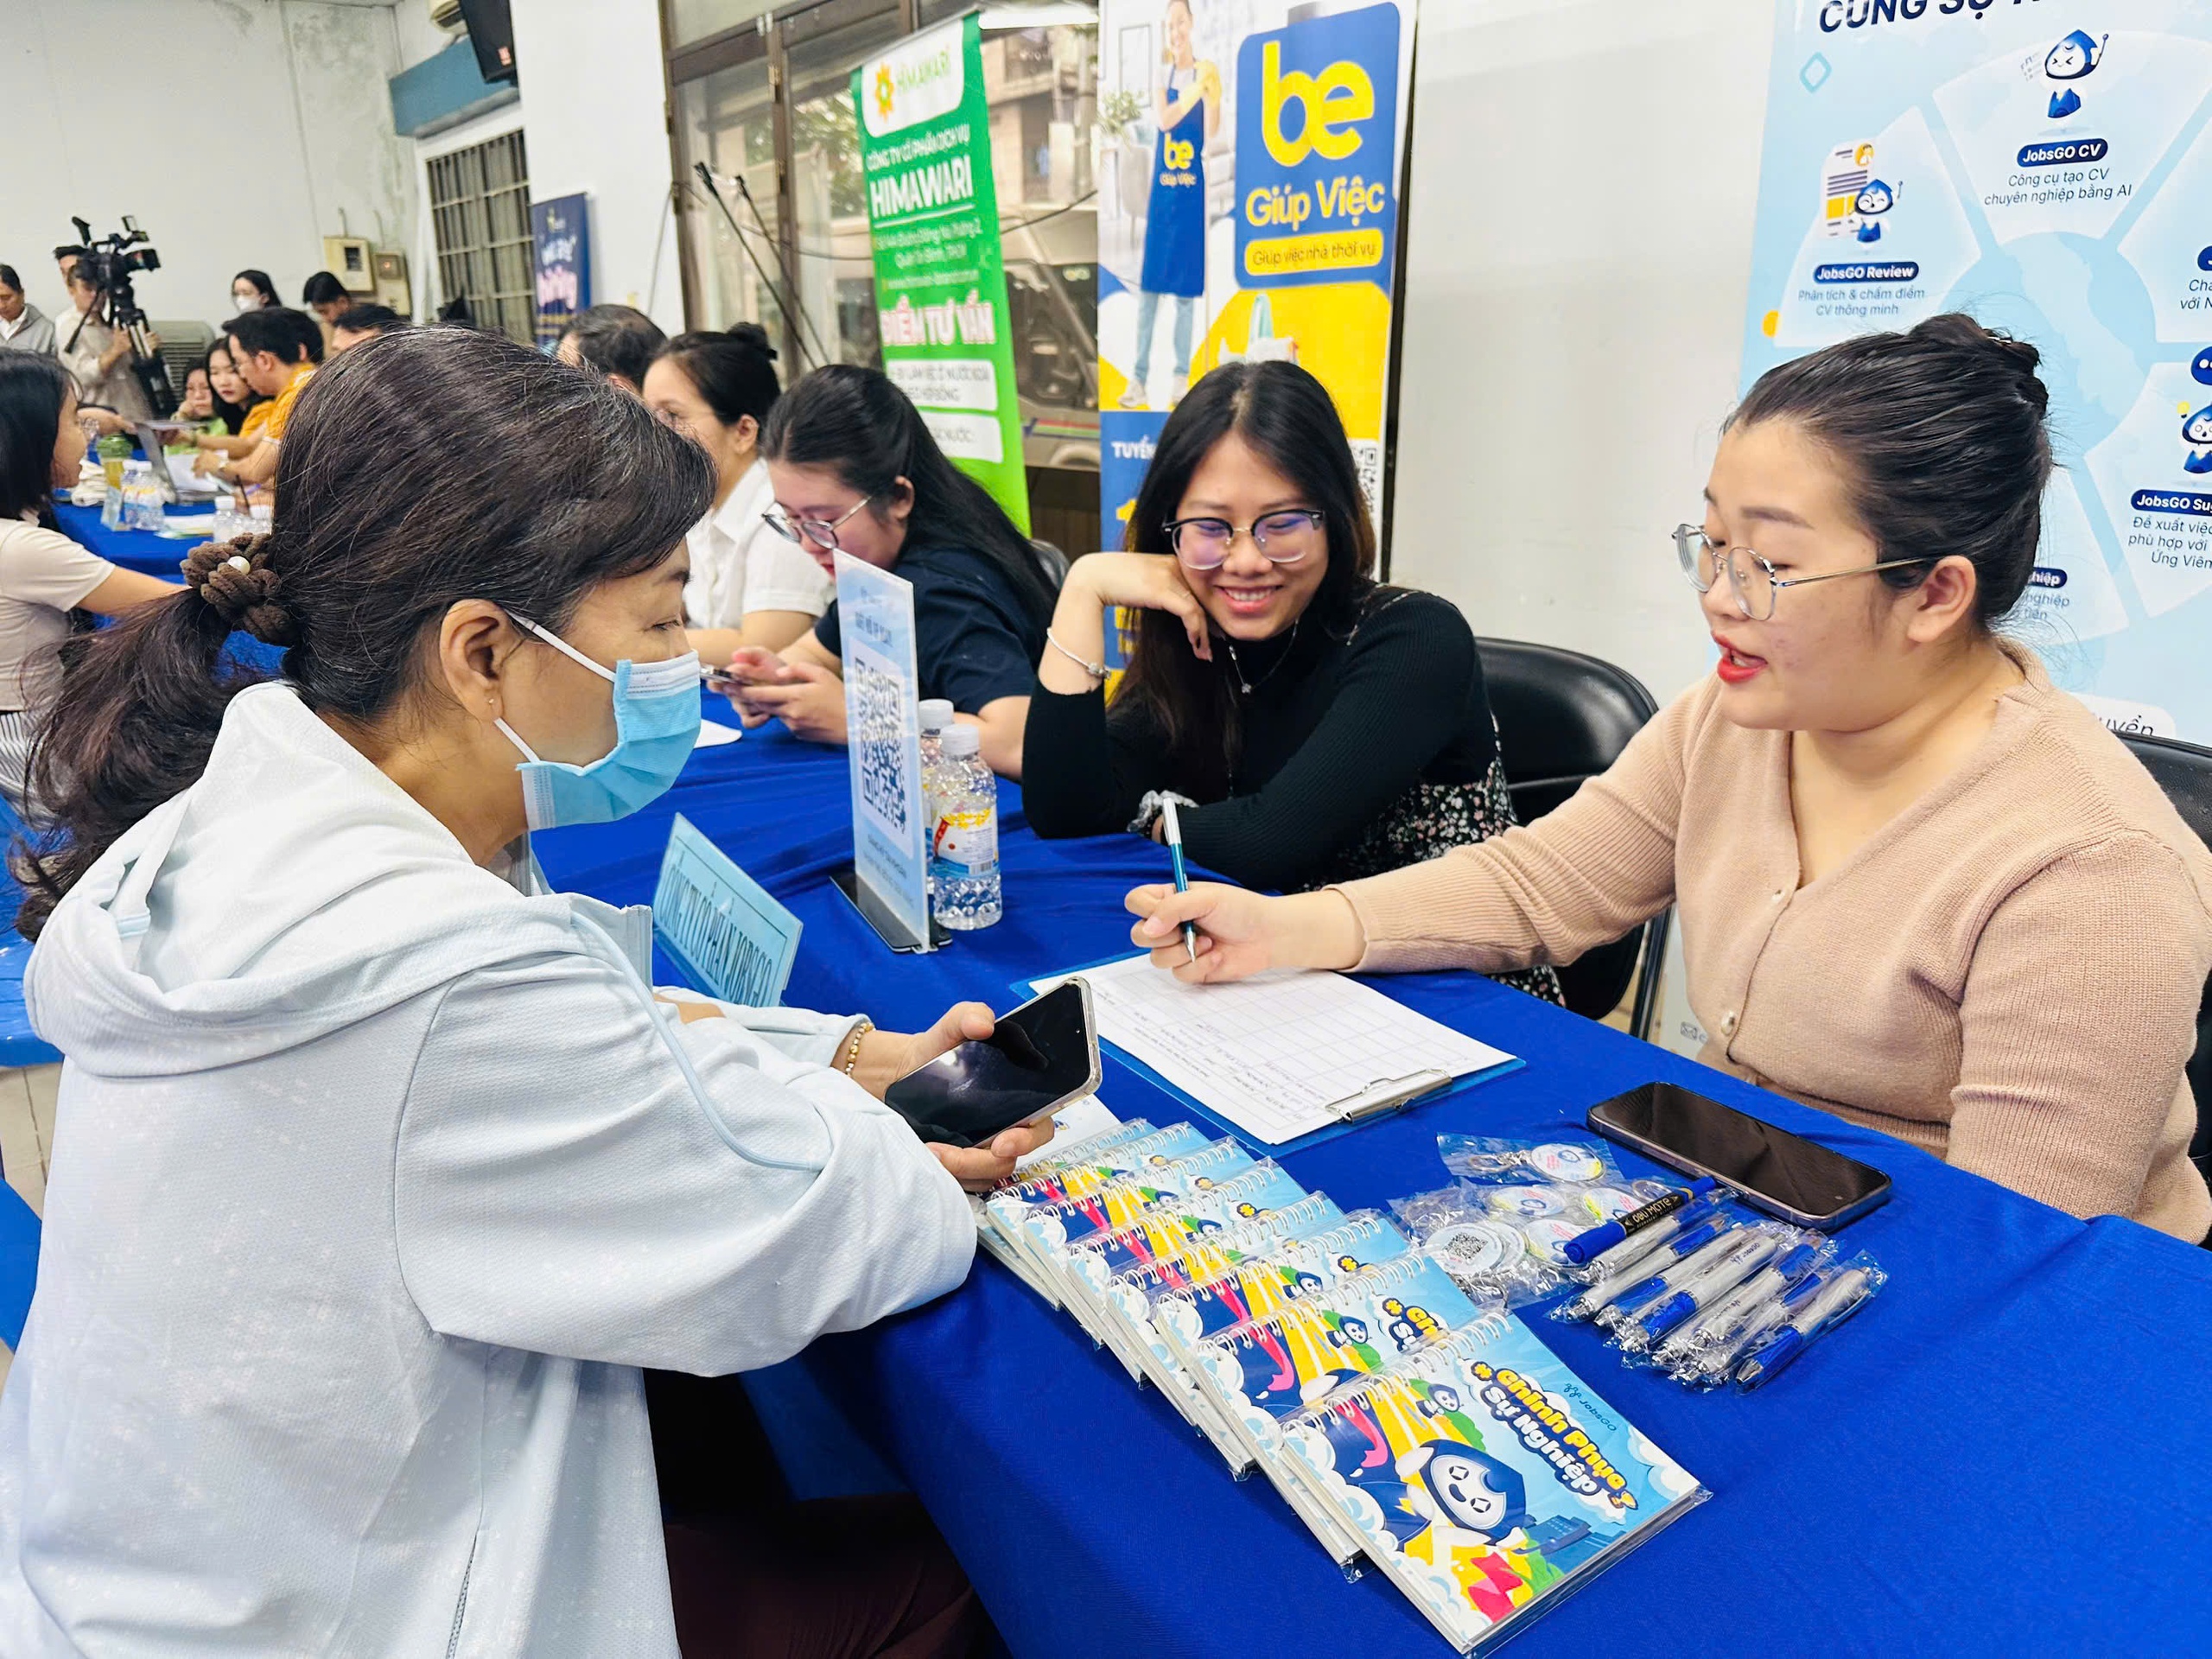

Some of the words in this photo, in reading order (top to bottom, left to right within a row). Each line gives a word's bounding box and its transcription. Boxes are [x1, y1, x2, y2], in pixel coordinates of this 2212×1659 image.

[1262, 41, 1375, 167] be
[1164, 132, 1194, 170] be
[2023, 146, 2075, 162] JobsGO
[2078, 143, 2101, 158] CV
[869, 154, 974, 219] HIMAWARI
[2008, 174, 2040, 188] Công
[2044, 173, 2059, 187] cụ
[2063, 171, 2083, 185] tạo
[2088, 168, 2110, 181] CV
[1245, 184, 1311, 231] Giúp
[1316, 176, 1385, 226] Việc
[1984, 191, 2027, 207] chuyên
[2031, 188, 2074, 204] nghiệp
[2078, 184, 2113, 200] bằng
[2117, 184, 2133, 197] AI
[1817, 267, 1864, 280] JobsGO
[1866, 265, 1915, 279] Review
[1798, 289, 1823, 302] Phân
[1827, 289, 1845, 301] tích
[1848, 289, 1856, 301] &
[1859, 286, 1892, 300] chấm
[2180, 296, 2201, 310] với
[1816, 305, 1832, 316] CV
[1834, 303, 1867, 318] thông
[1870, 303, 1899, 315] minh
[2137, 494, 2190, 509] JobsGO
[2155, 517, 2184, 532] xuất
[2128, 533, 2153, 548] phù
[2158, 536, 2183, 550] hợp
[2188, 538, 2208, 551] với
[2151, 549, 2178, 569] Ứng
[1580, 1397, 1618, 1433] JobsGO
[1484, 1386, 1522, 1418] Sự
[1512, 1414, 1598, 1492] Nghiệp
